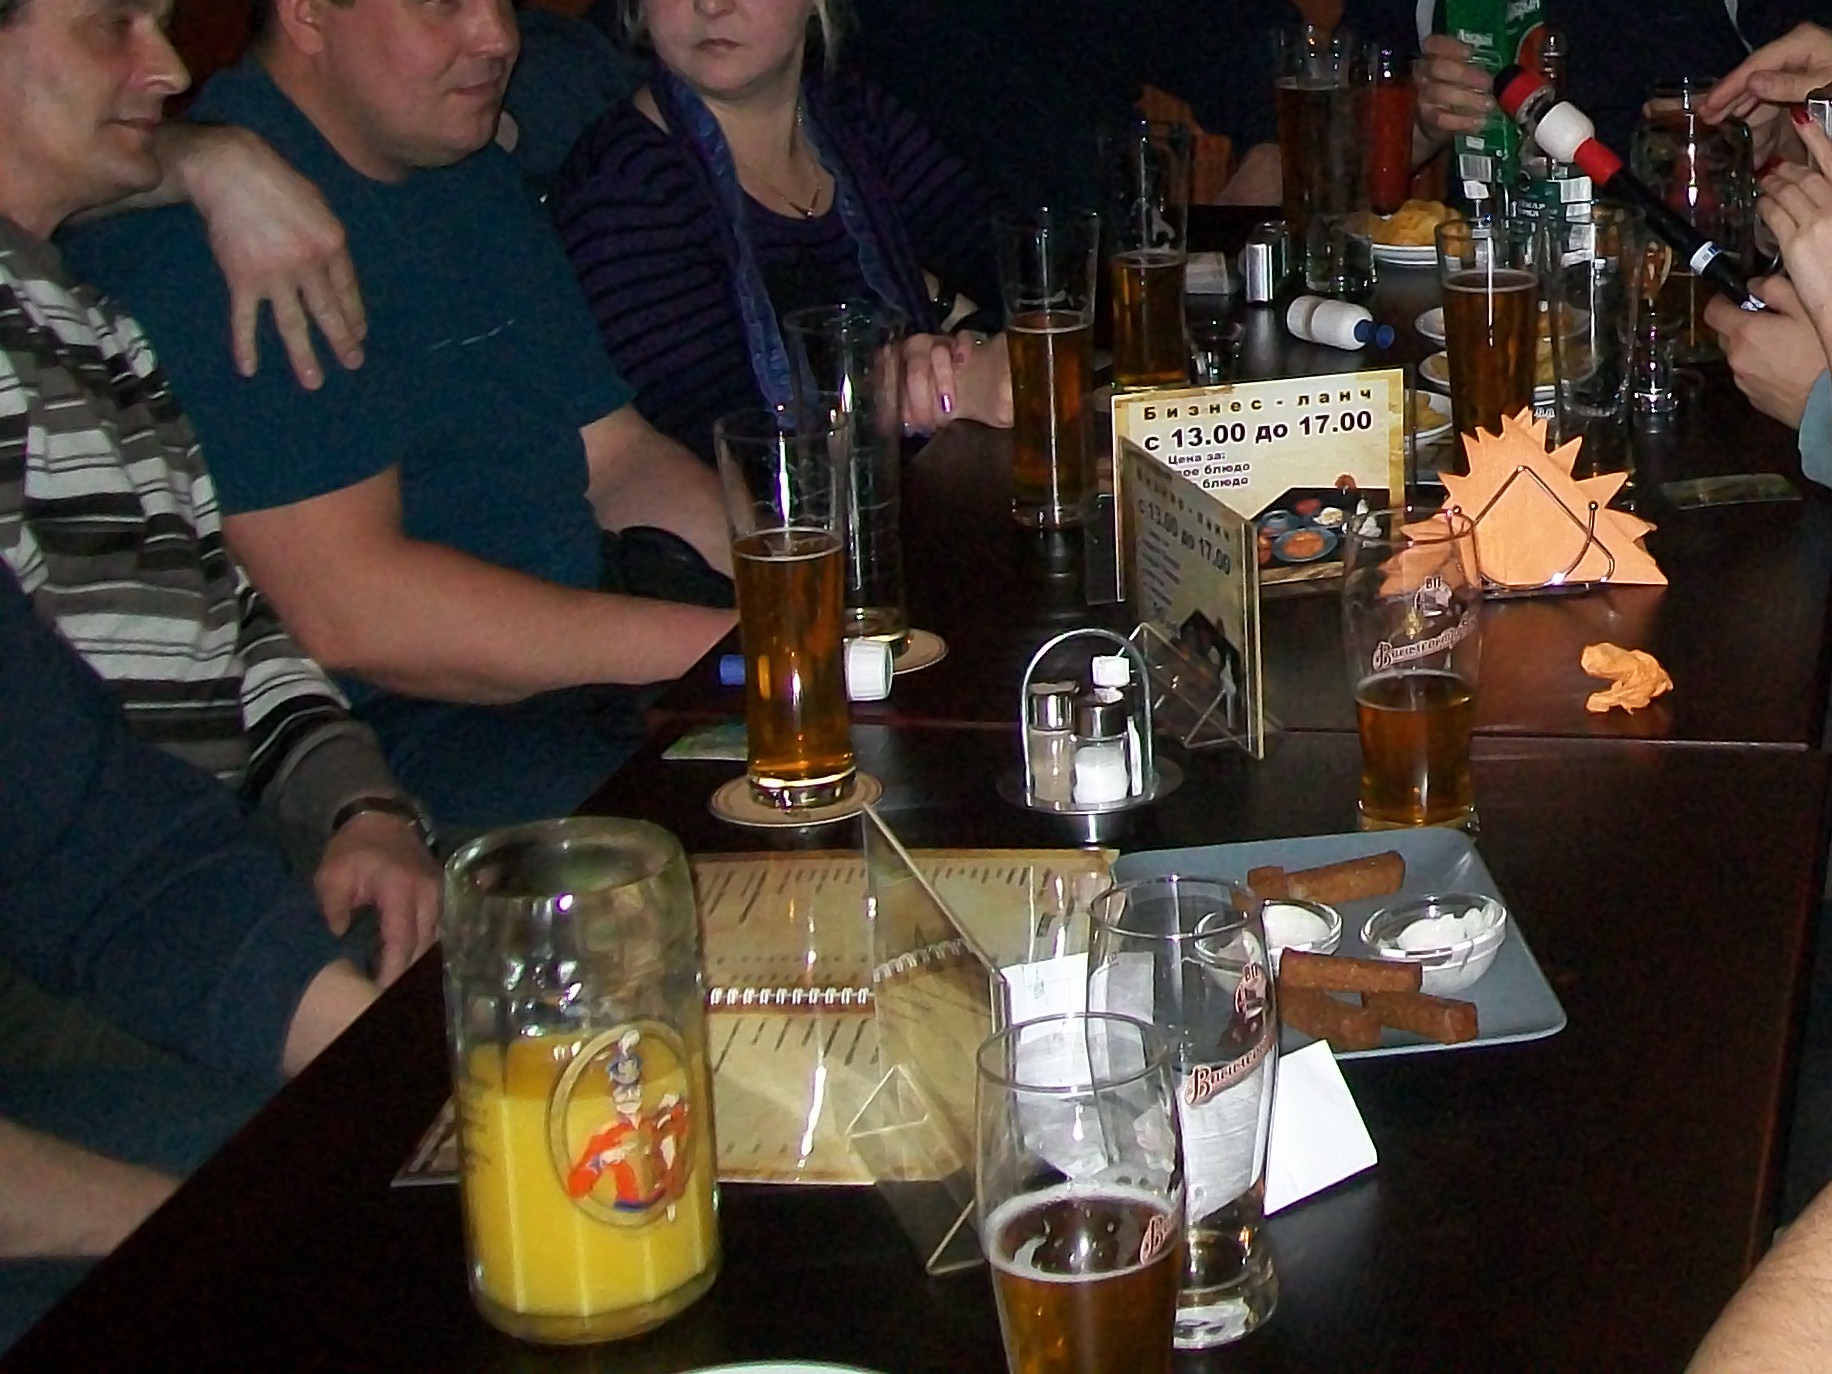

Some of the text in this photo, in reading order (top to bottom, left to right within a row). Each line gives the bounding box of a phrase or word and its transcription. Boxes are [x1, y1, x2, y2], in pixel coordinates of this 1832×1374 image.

[1144, 399, 1262, 420] Бизнес
[1297, 389, 1372, 407] ланч
[1144, 411, 1372, 451] с 13.00 до 17.00
[1168, 452, 1226, 466] Цена за:
[1204, 463, 1250, 475] блюдо
[1202, 477, 1249, 489] блюдо
